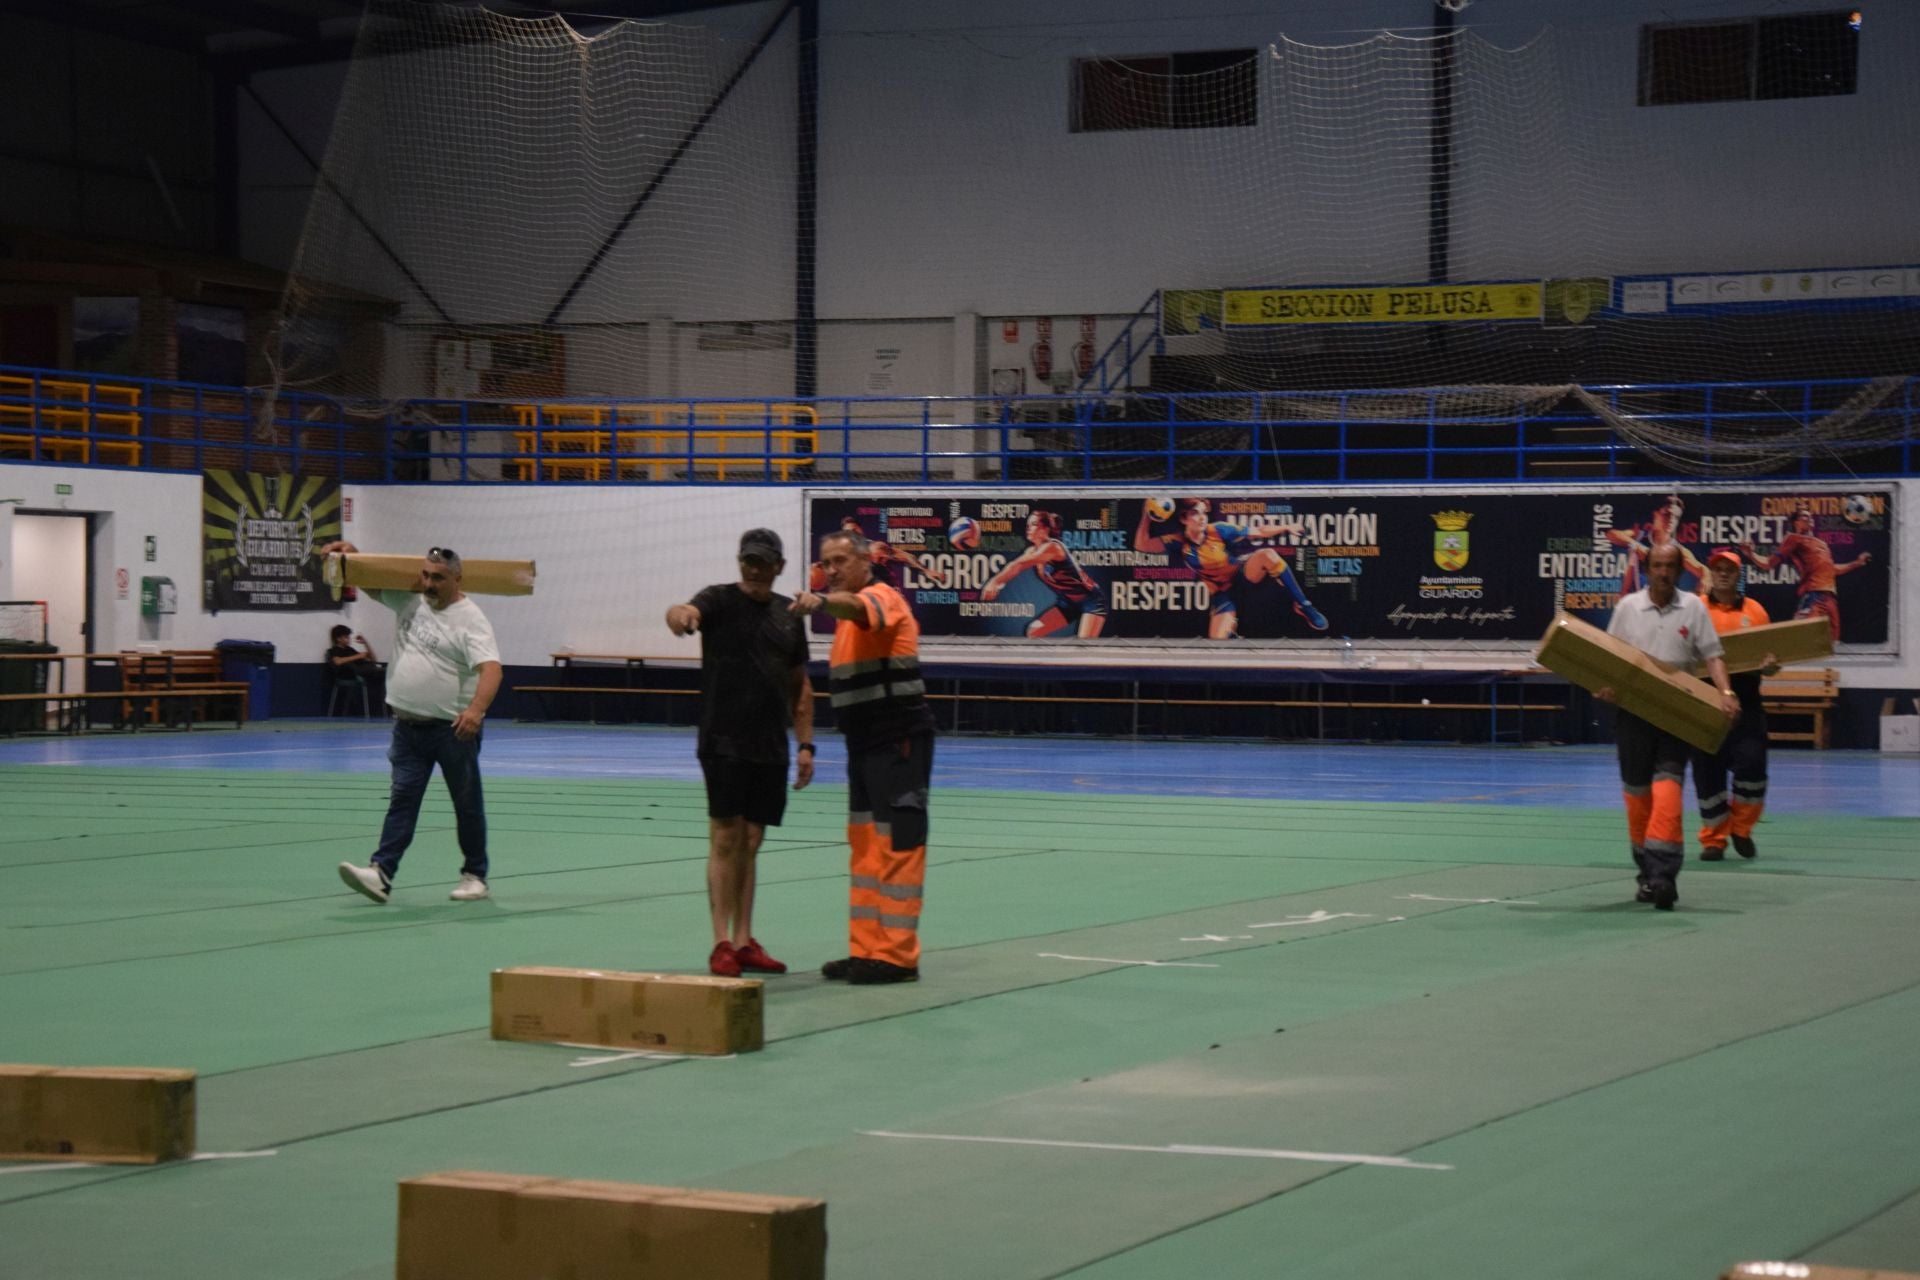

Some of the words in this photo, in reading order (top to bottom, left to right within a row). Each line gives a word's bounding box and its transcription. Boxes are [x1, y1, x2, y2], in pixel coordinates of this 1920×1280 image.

[1260, 291, 1374, 318] SECCION
[1387, 289, 1495, 315] PELUSA
[887, 507, 934, 517] DEPORTIVIDAD
[981, 504, 1029, 519] RESPETO
[1220, 503, 1266, 514] SACRIFICIO
[1761, 497, 1885, 515] CONCENTRN
[1076, 519, 1101, 530] METAS
[1593, 503, 1614, 551] METAS
[1701, 516, 1788, 543] RESPET
[887, 528, 926, 543] METAS
[1062, 531, 1127, 549] BALANCE
[903, 553, 1008, 590] LOGROS
[1317, 558, 1363, 575] METAS
[1538, 553, 1628, 577] ENTREGA
[1420, 575, 1484, 586] Ayuntamiento
[1746, 563, 1801, 584] BALAN
[1565, 579, 1622, 592] SACRIFICIO
[916, 591, 959, 604] ENTREGA
[1112, 581, 1211, 611] RESPETO
[1419, 589, 1484, 599] GUARDO
[959, 602, 1036, 617] DEPORTIVIDAD
